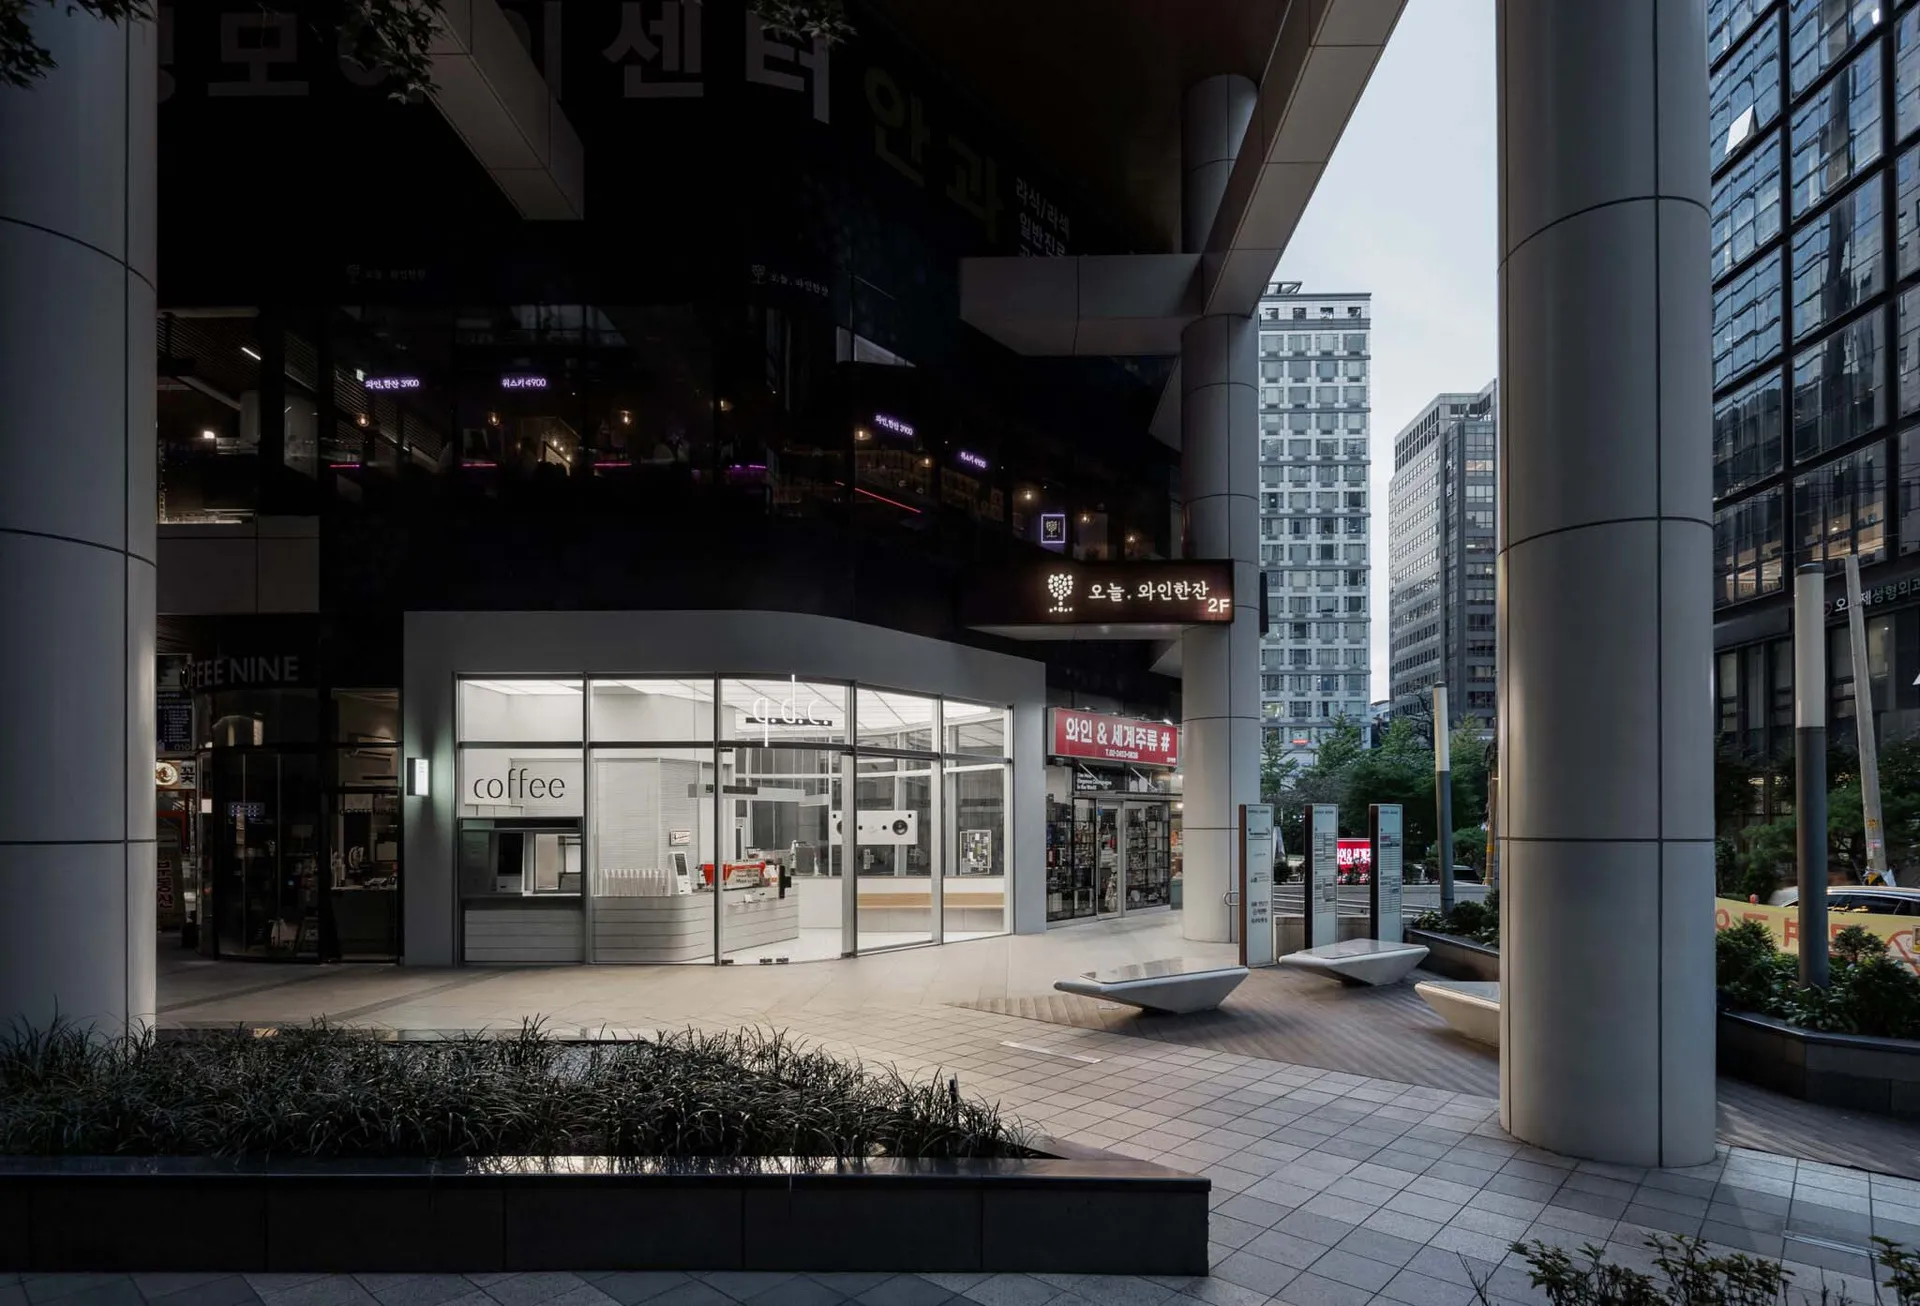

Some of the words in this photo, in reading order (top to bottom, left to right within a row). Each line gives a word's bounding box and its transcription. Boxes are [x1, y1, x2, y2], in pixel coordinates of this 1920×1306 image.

[864, 65, 1004, 244] 안과
[502, 378, 525, 388] 위스키
[525, 378, 547, 387] 4900
[1088, 582, 1132, 602] 오늘.
[1137, 580, 1209, 601] 와인한잔
[1207, 597, 1230, 613] 2F
[229, 655, 299, 683] NINE
[1066, 717, 1093, 743] 와인
[1097, 722, 1107, 745] &
[1111, 723, 1158, 752] 세계주류
[1161, 732, 1170, 752] #
[473, 768, 566, 799] coffee
